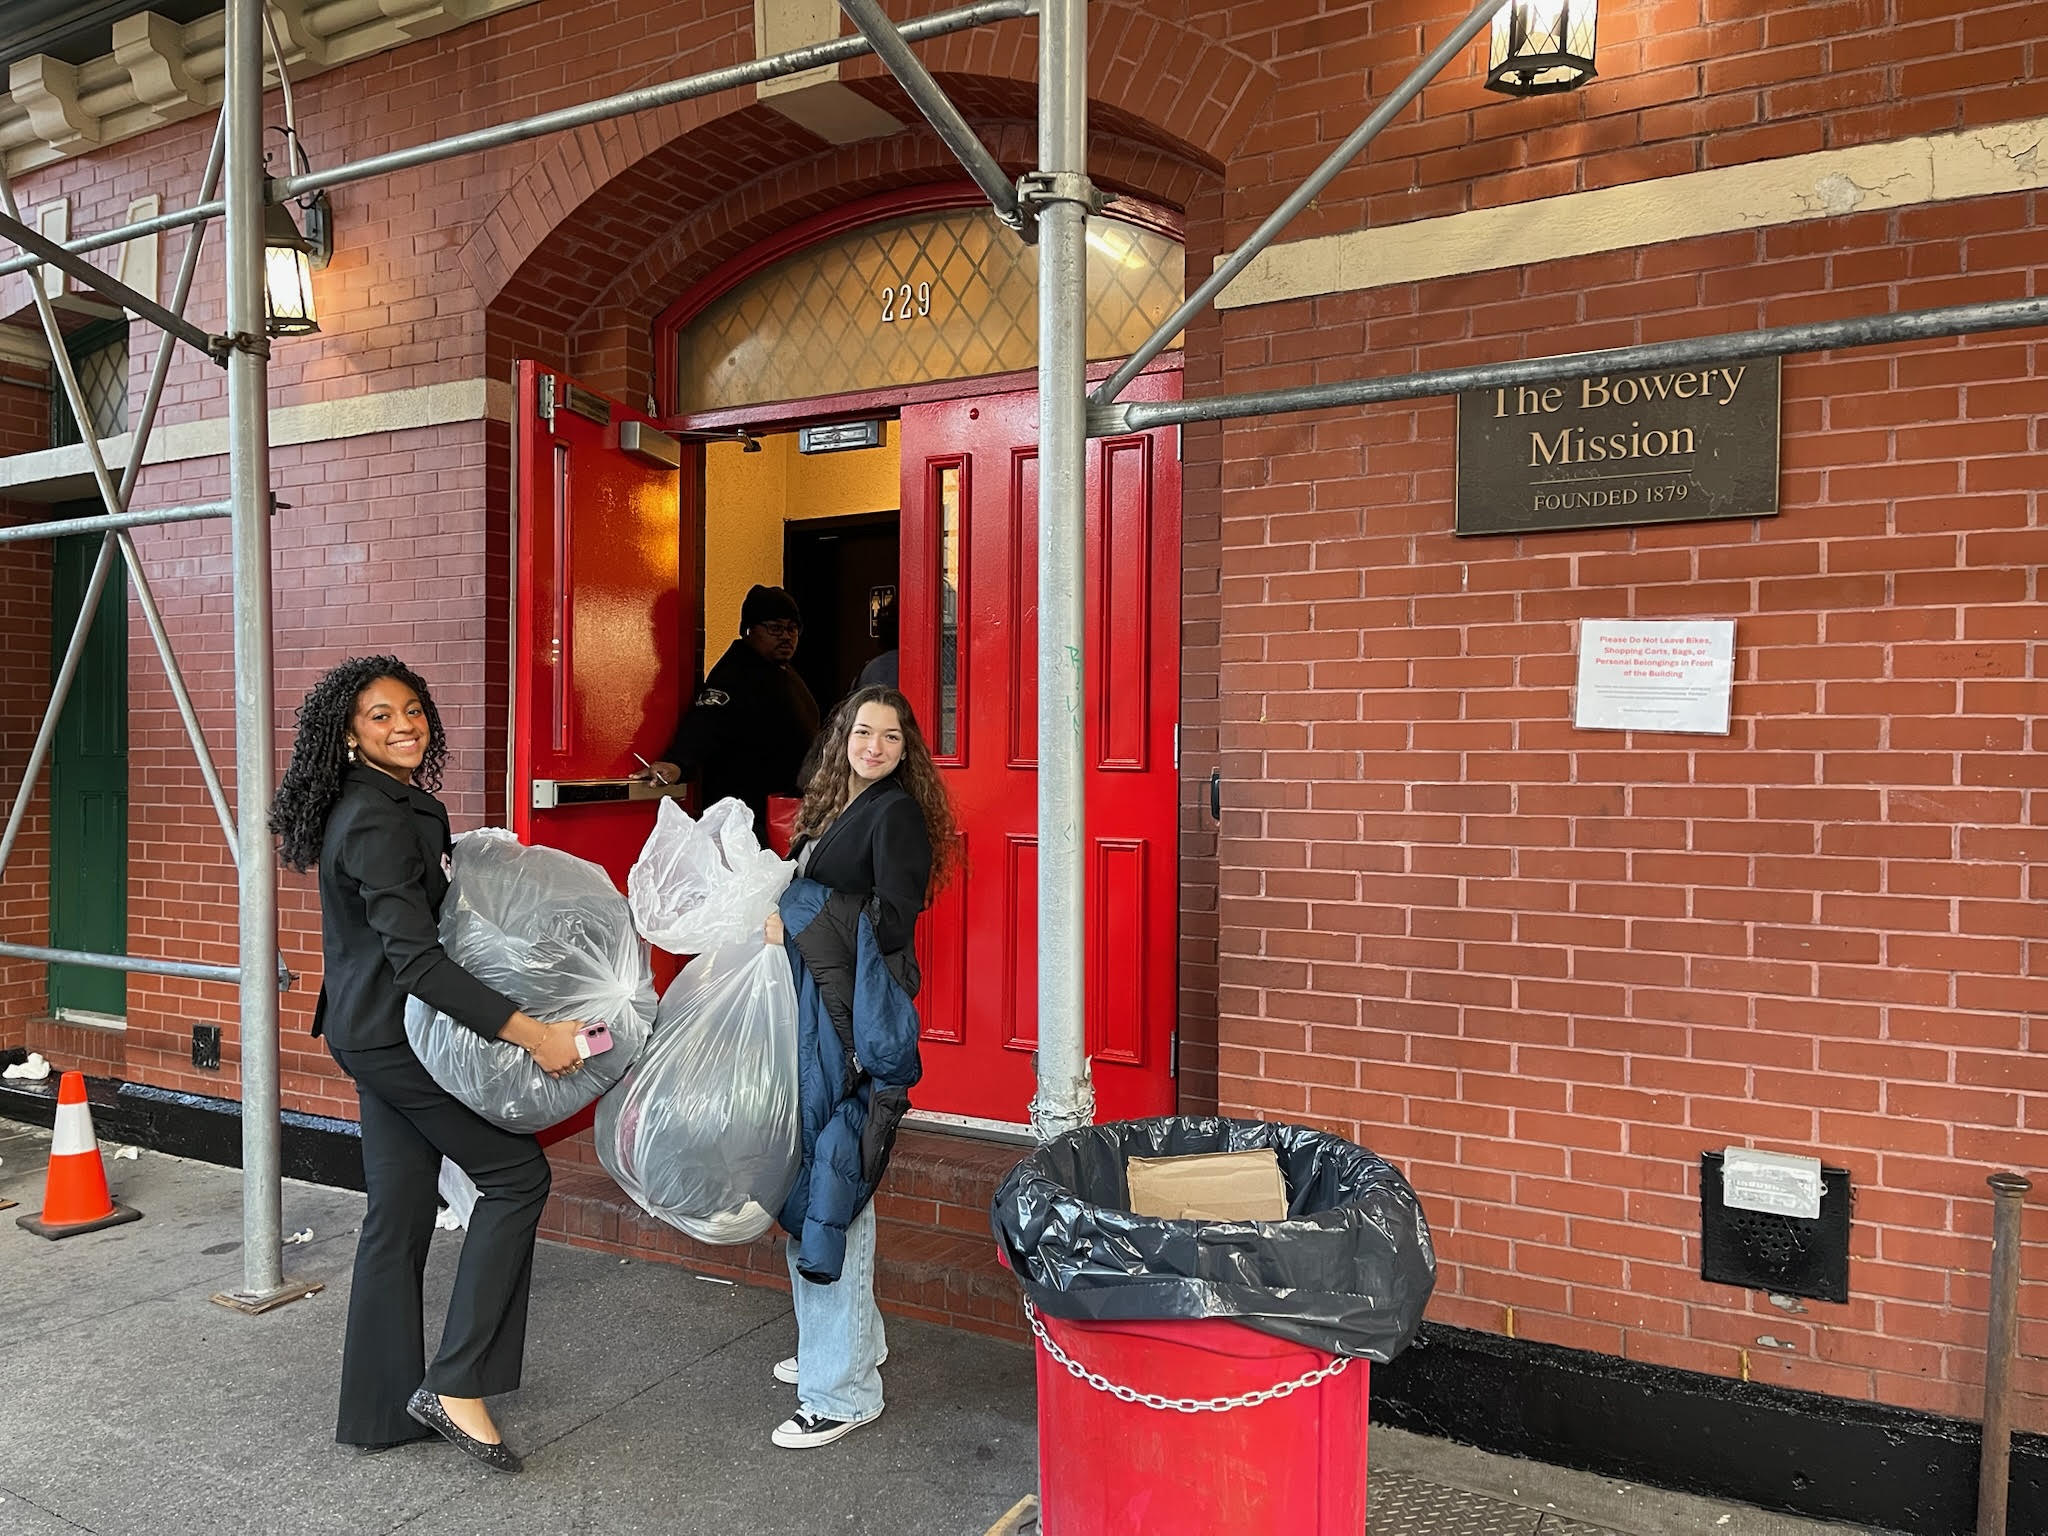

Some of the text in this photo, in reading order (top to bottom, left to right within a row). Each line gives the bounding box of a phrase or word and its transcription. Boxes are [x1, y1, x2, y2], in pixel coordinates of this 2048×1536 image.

[881, 281, 930, 322] 229
[1487, 366, 1747, 418] The Bowery
[1528, 421, 1697, 467] Mission
[1533, 485, 1688, 511] FOUNDED 1879
[1600, 636, 1627, 644] Please
[1629, 636, 1641, 644] Do
[1660, 637, 1684, 645] Leave
[1686, 637, 1712, 645] Bikes,
[1604, 647, 1643, 656] Shopping
[1672, 648, 1695, 656] Bags,
[1634, 659, 1679, 667] Belongings
